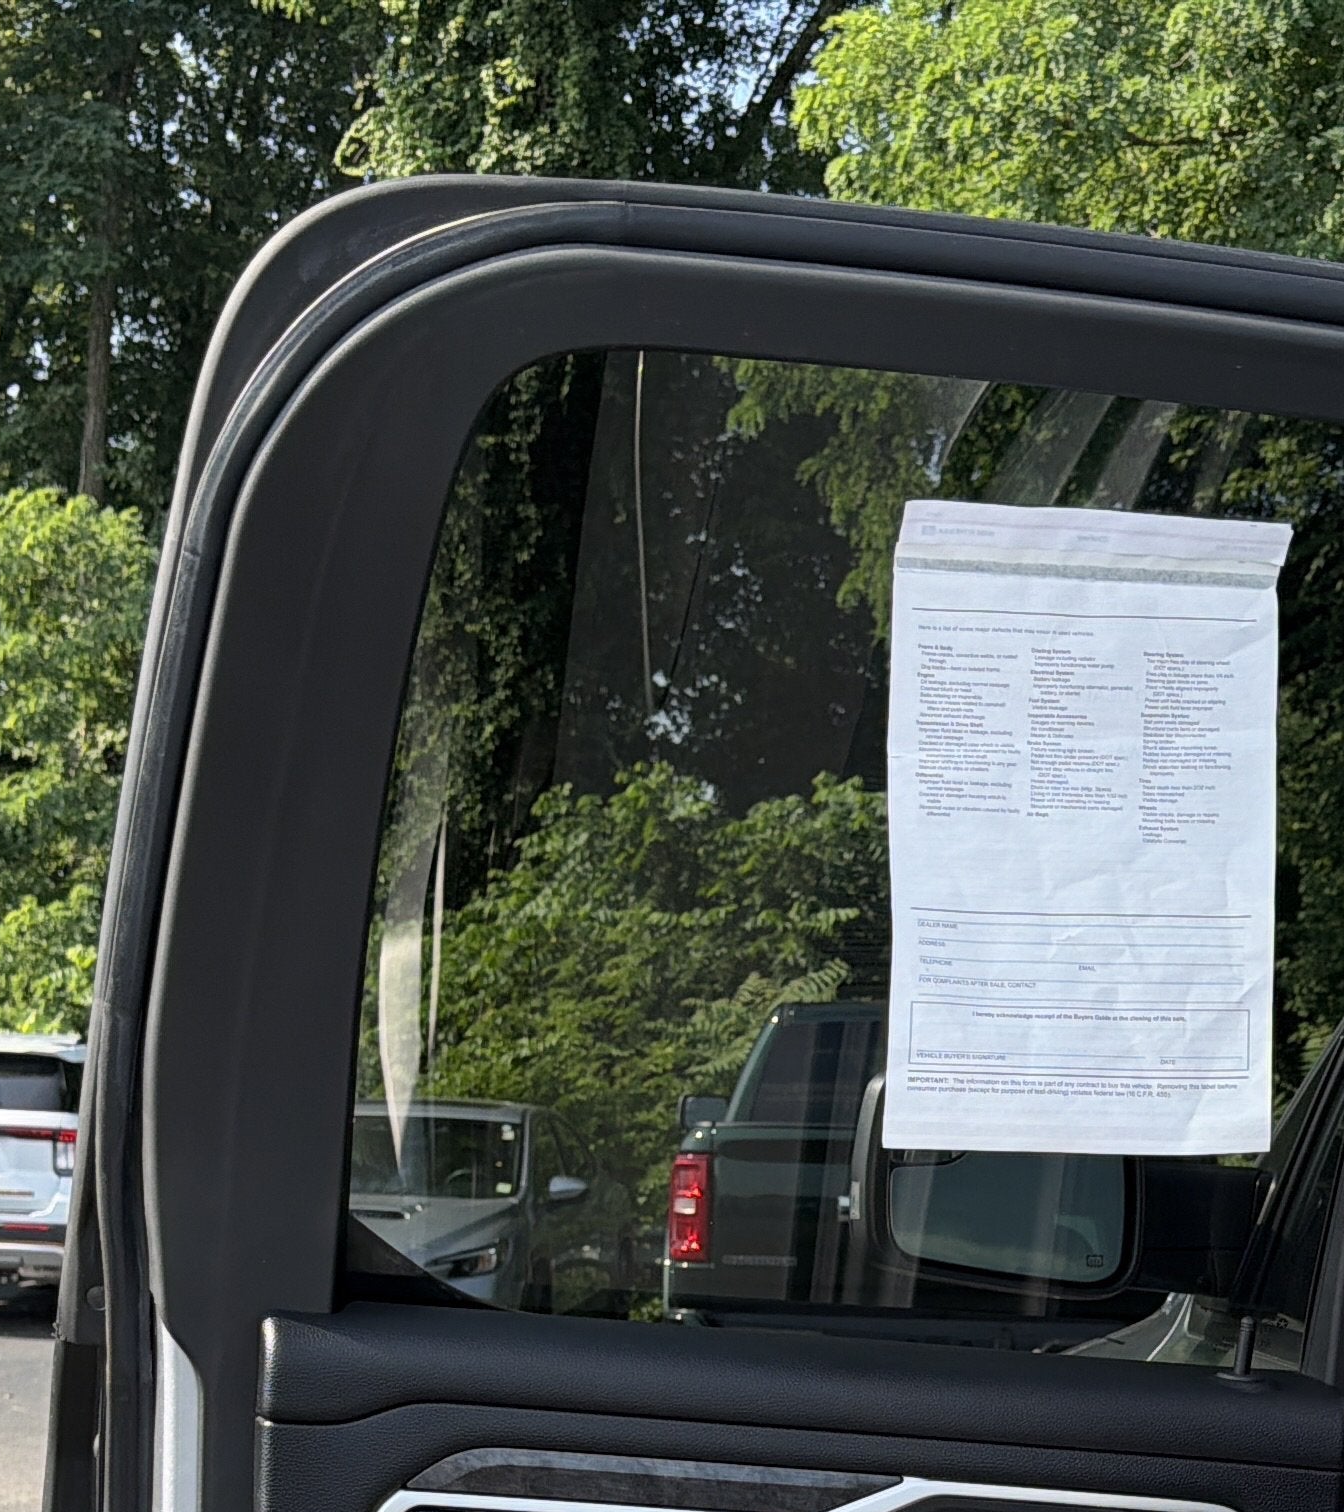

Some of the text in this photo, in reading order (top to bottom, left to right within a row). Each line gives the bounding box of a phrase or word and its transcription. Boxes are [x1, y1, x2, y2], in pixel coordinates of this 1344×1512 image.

[920, 958, 953, 966] TELEPHONE
[932, 977, 969, 986] COMPLAINTS
[996, 1012, 1033, 1020] acknowledge
[972, 1053, 1006, 1061] SIGNATURE
[907, 1076, 949, 1084] IMPORTANT:
[1022, 1079, 1037, 1087] form
[1044, 1080, 1056, 1088] part
[1108, 1082, 1119, 1090] buy
[1156, 1083, 1188, 1091] Removing
[938, 1086, 967, 1094] purchase
